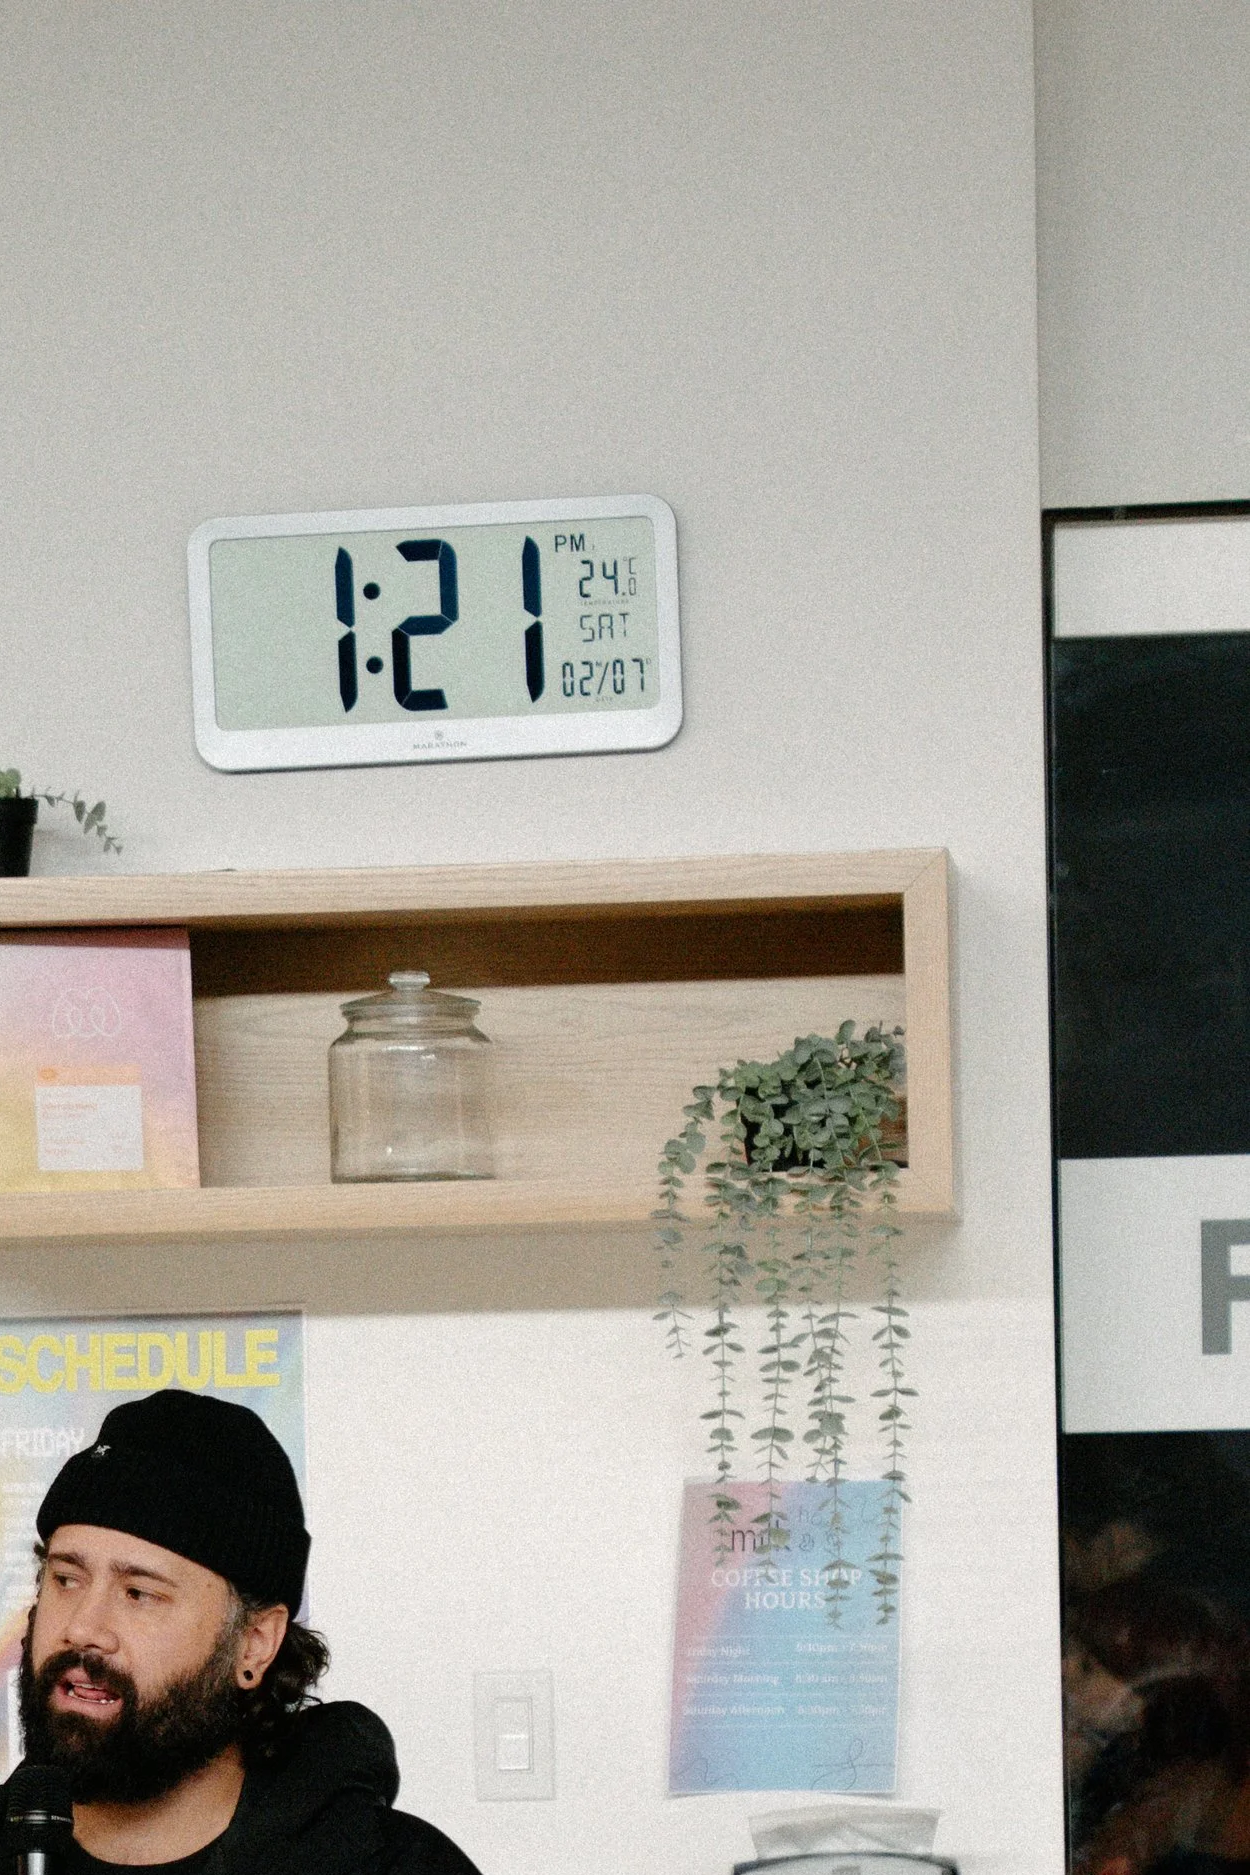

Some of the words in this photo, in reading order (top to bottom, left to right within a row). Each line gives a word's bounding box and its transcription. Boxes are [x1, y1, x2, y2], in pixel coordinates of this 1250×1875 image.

[554, 533, 586, 553] PM
[334, 535, 545, 713] 1:21
[579, 612, 630, 643] SAT
[1, 1426, 86, 1459] FRIDAY
[710, 1567, 792, 1588] COFFEE
[743, 1590, 827, 1611] HOURS
[732, 1671, 780, 1686] Morning
